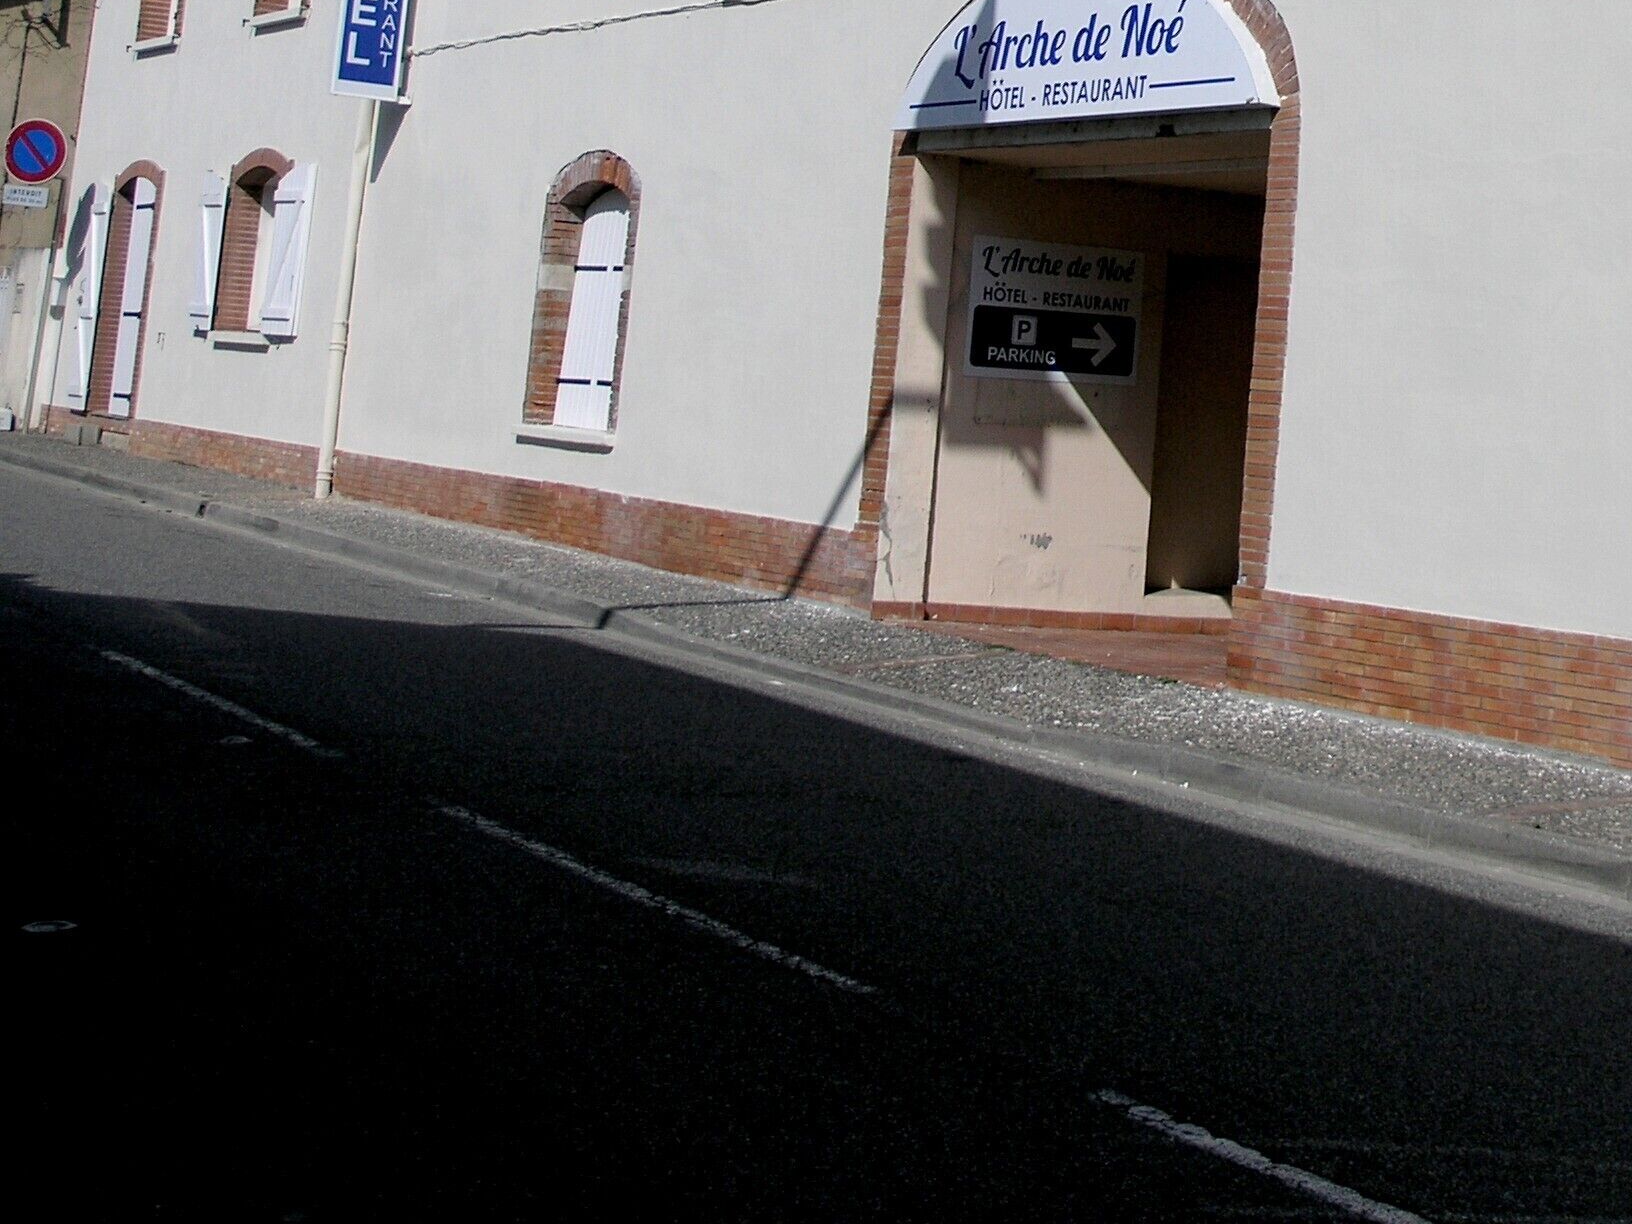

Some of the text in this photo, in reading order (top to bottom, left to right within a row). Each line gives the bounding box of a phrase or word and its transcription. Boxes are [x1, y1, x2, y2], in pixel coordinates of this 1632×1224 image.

[953, 18, 1067, 90] L'Arche
[1071, 12, 1111, 62] de
[1041, 75, 1148, 107] RESTAURANT
[982, 245, 1136, 283] L'Arche de Noé
[1042, 291, 1130, 312] RESTAURANT
[1017, 320, 1031, 340] P
[987, 346, 1056, 365] PARKING
